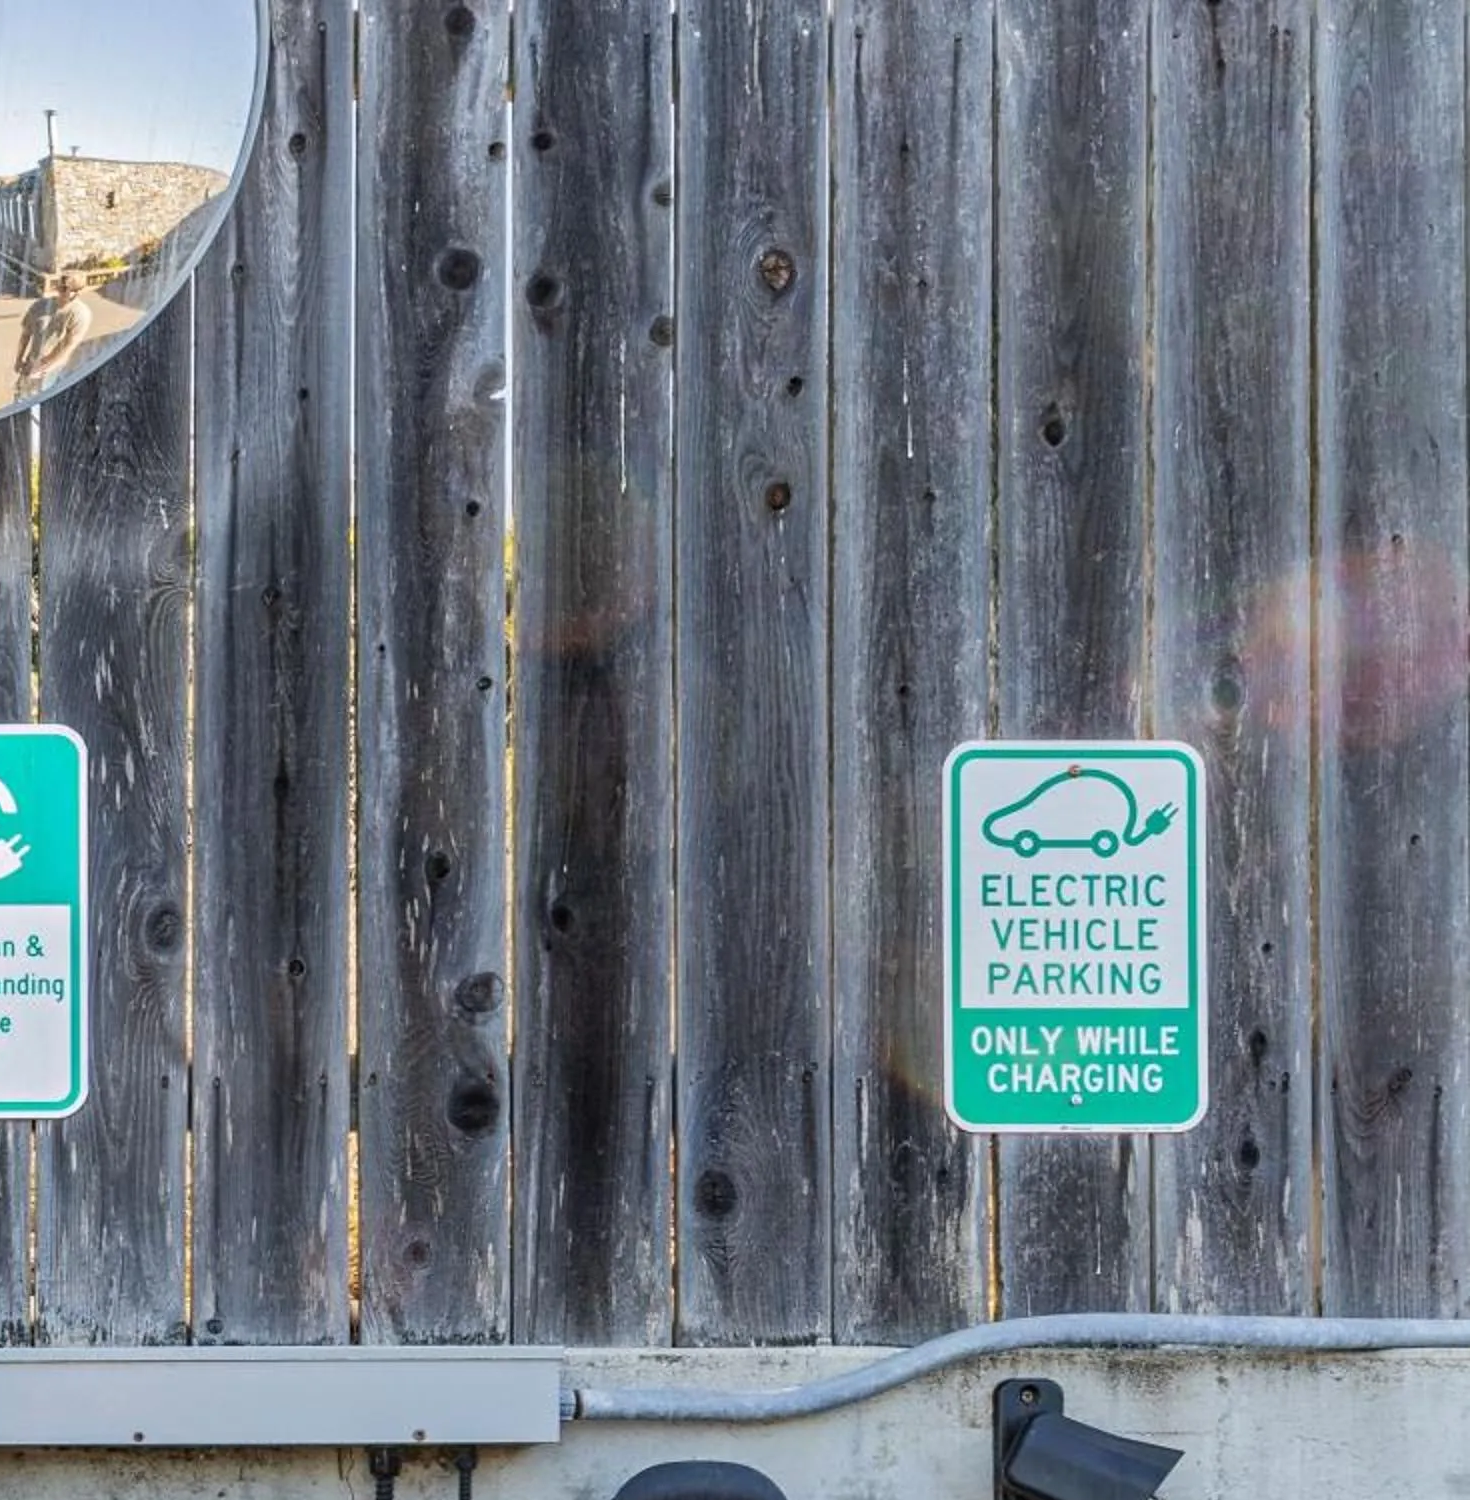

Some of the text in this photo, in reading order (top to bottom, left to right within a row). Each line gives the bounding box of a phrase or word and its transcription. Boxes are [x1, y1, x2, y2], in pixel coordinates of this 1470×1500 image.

[981, 875, 1166, 907] ELECTRIC
[26, 935, 44, 958] &
[992, 918, 1159, 951] VEHICLE
[987, 962, 1162, 995] PARKING
[970, 1025, 1180, 1056] ONLY WHILE
[987, 1062, 1163, 1094] CHARGING
